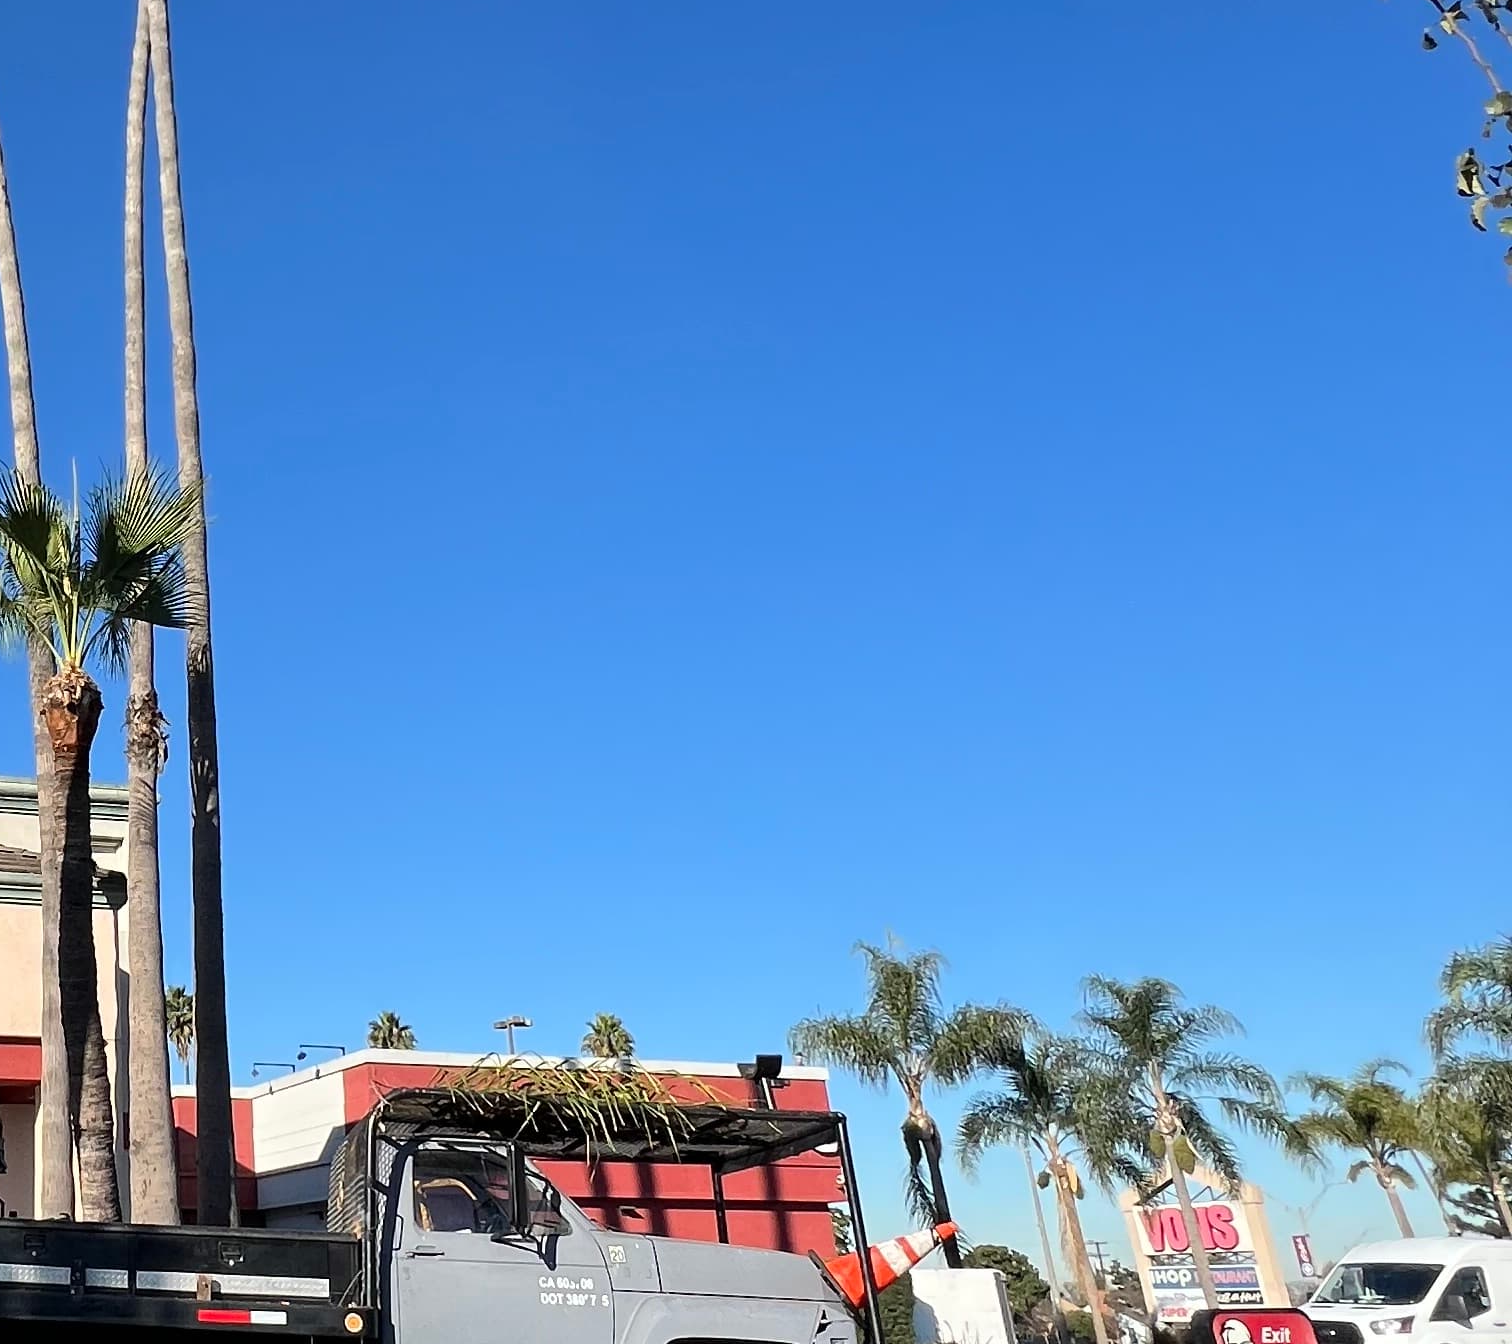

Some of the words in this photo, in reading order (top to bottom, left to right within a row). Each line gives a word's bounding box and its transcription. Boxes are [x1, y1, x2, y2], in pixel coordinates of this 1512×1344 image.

[538, 1276, 555, 1289] CA
[1151, 1268, 1192, 1287] IHOP
[540, 1292, 564, 1305] DOT
[1261, 1326, 1291, 1344] Exit
